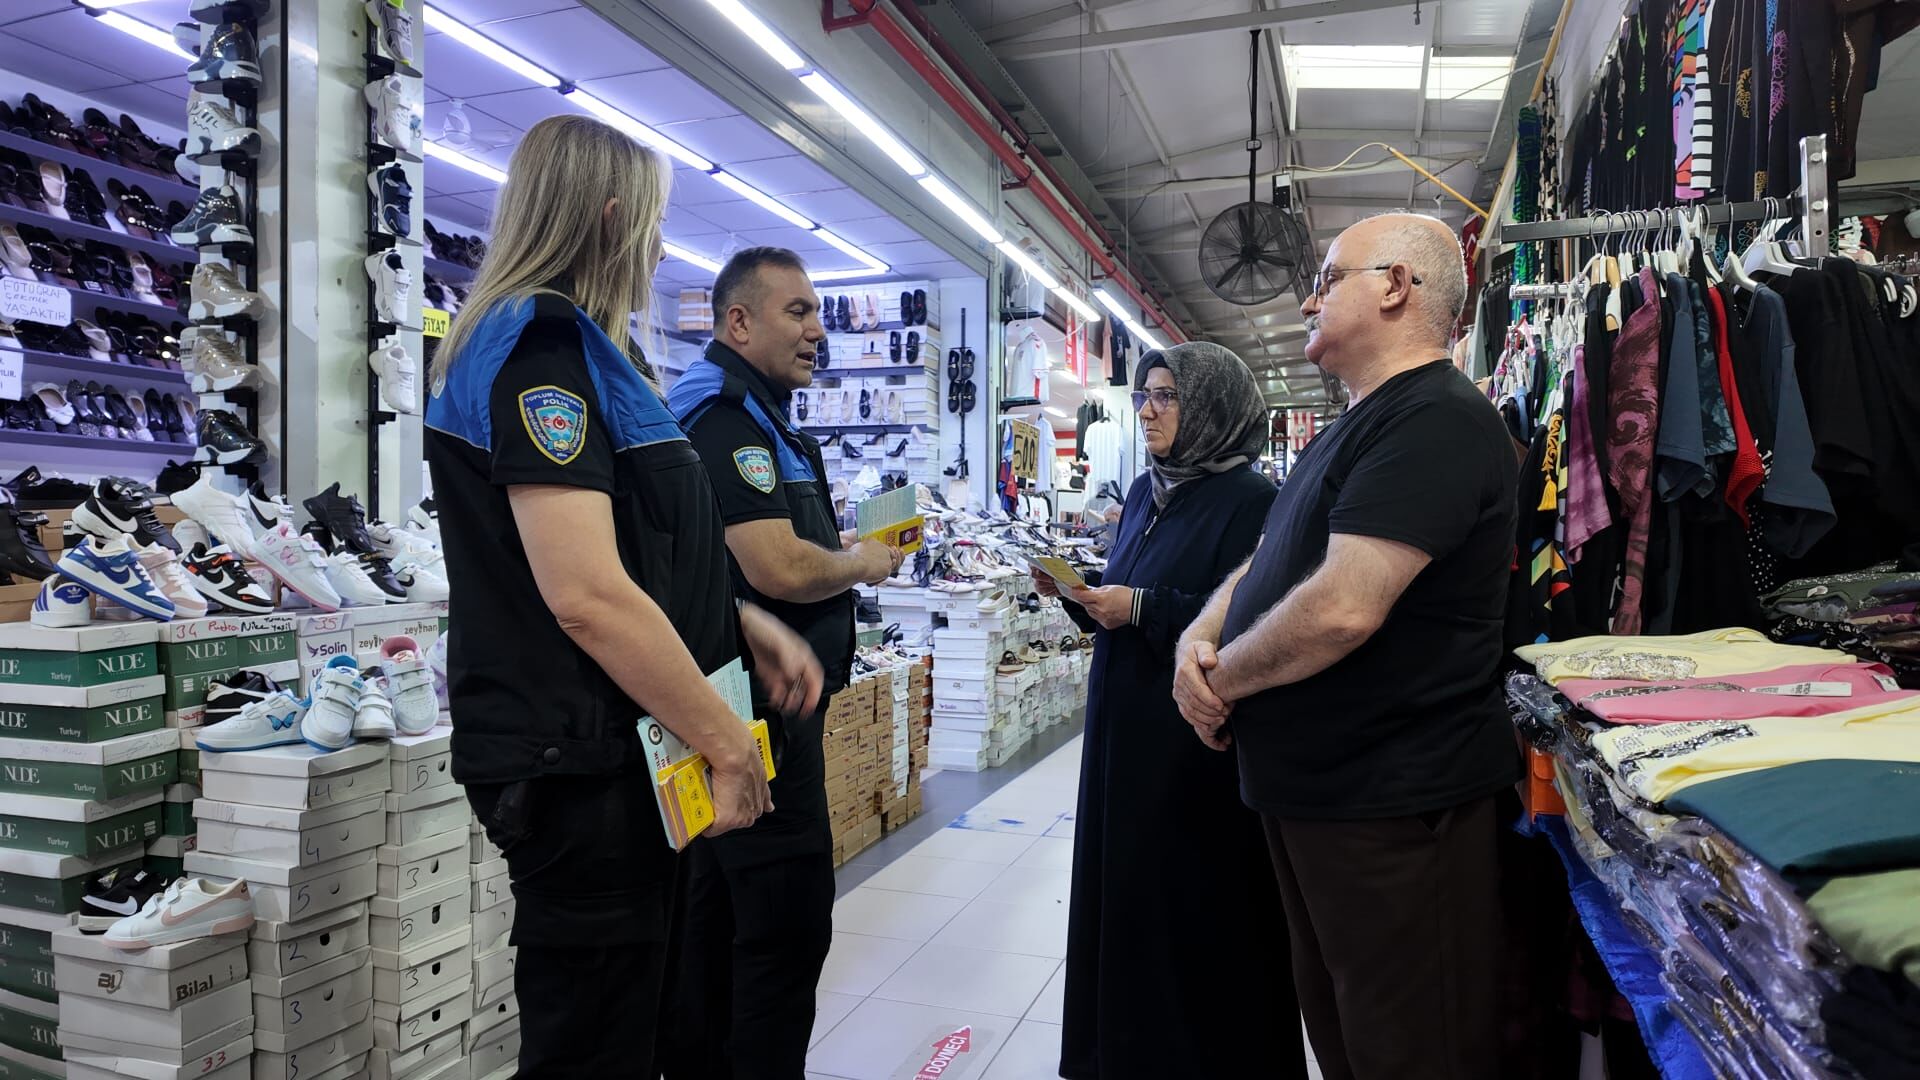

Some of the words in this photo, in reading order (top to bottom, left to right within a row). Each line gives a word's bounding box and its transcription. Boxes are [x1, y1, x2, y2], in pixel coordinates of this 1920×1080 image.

[524, 392, 554, 403] TOPLUM
[1013, 434, 1035, 473] 500
[314, 616, 338, 631] 35
[186, 641, 227, 660] NUDE
[249, 635, 286, 655] NUDE
[319, 641, 348, 657] Solin
[96, 652, 146, 675] NUDE
[50, 672, 72, 682] Turkey
[104, 704, 152, 728] NUDE
[59, 727, 81, 738] Turkey
[4, 765, 40, 784] NUDE
[120, 760, 166, 786] NUDE
[411, 764, 429, 792] 5
[73, 783, 96, 794] Turkey
[47, 837, 69, 848] Turkey
[95, 824, 137, 849] NUDE
[305, 838, 320, 864] 4
[406, 867, 420, 890] 3
[295, 885, 310, 913] 5
[486, 881, 497, 902] 4
[400, 918, 414, 940] 5
[287, 942, 308, 961] 2
[176, 974, 214, 1002] Bilal
[405, 968, 419, 991] 3
[289, 1000, 302, 1025] 3
[408, 1018, 424, 1037] 2
[201, 1051, 226, 1073] 33
[925, 1034, 968, 1074] DÖVMECİ
[288, 1054, 299, 1080] 3
